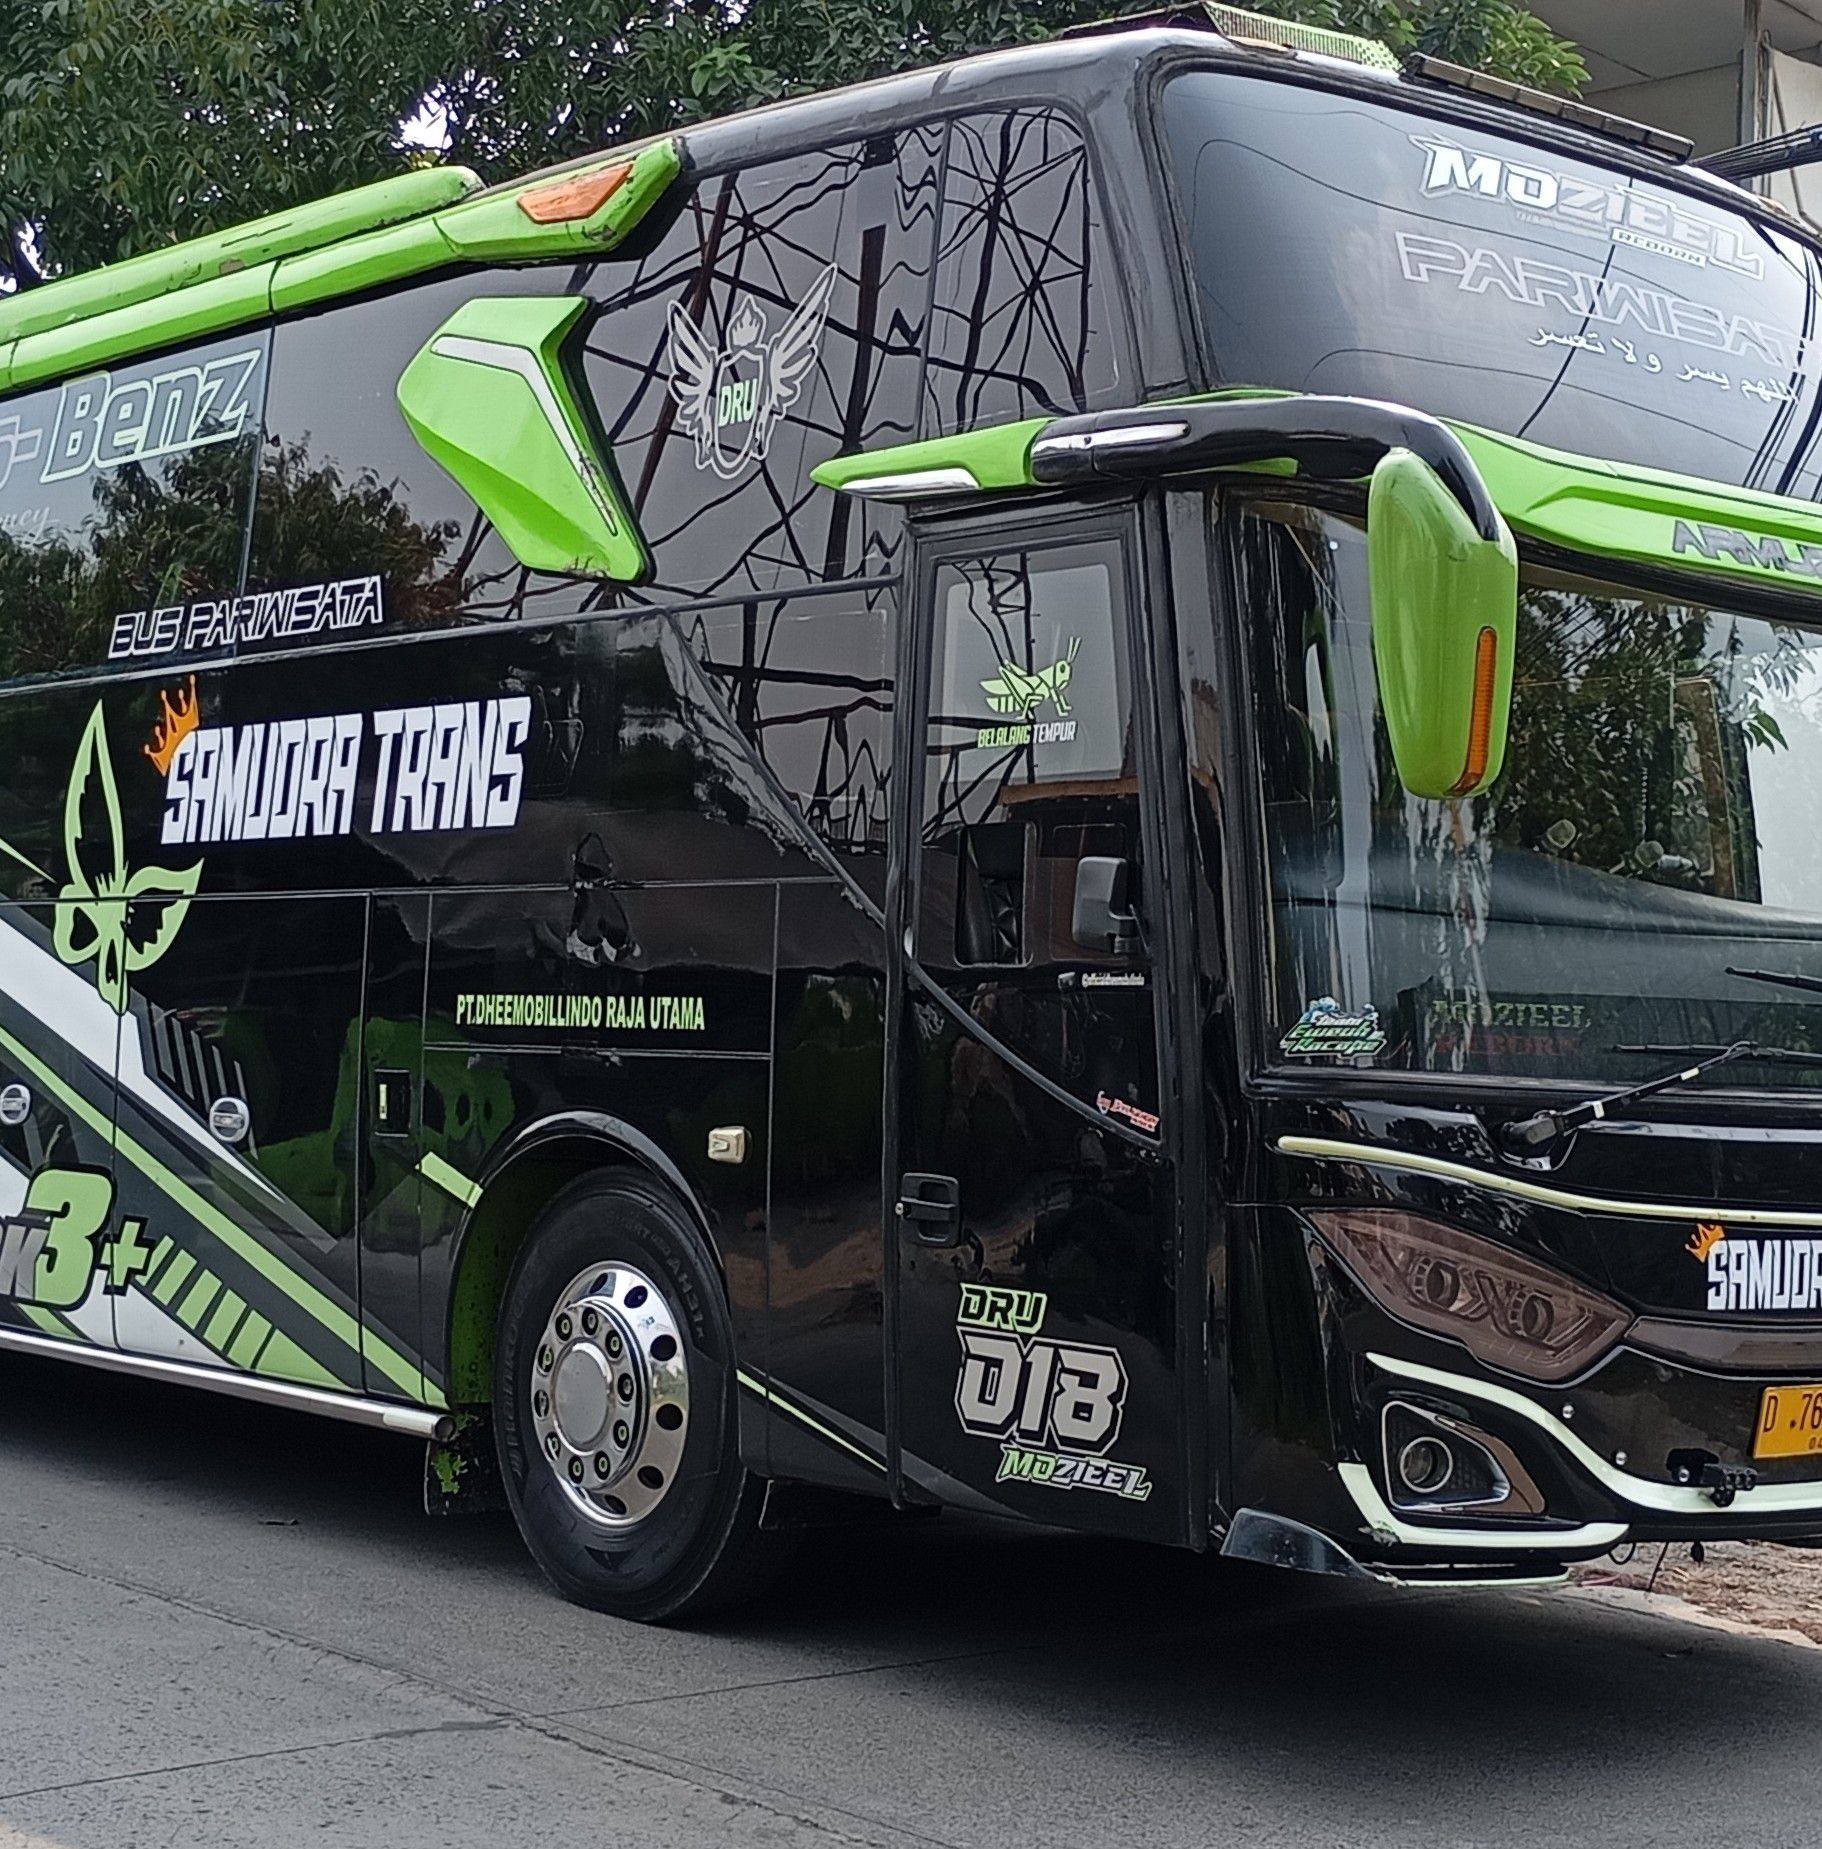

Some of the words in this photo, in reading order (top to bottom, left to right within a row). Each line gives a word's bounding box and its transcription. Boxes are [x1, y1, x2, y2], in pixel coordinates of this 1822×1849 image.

[1410, 136, 1765, 280] MOZIEEL
[718, 378, 758, 427] DRU
[108, 606, 185, 659] BUS
[184, 575, 384, 650] PARIWISATA
[977, 724, 1032, 748] BELALANG
[1033, 720, 1077, 744] TEMPUR
[160, 712, 363, 845] SAMUDRA
[370, 696, 532, 833] TRANS
[456, 994, 602, 1028] PT.DHEEMOBILLINDO
[605, 995, 646, 1029] RAJA
[650, 996, 706, 1031] UTAMA
[958, 1283, 1048, 1334] DRU
[1762, 1394, 1780, 1433] D
[996, 1444, 1153, 1501] MOZIEEL
